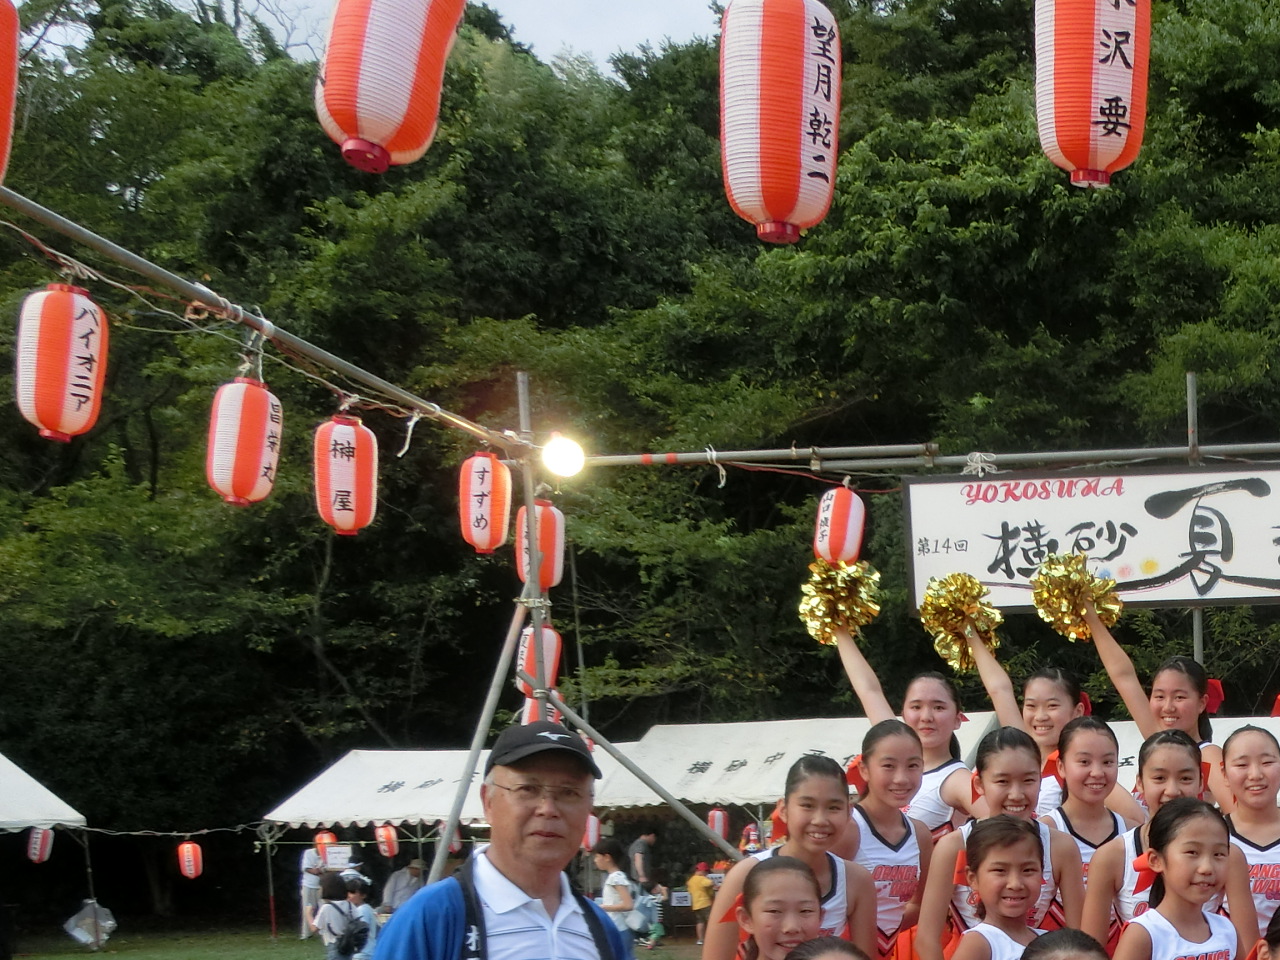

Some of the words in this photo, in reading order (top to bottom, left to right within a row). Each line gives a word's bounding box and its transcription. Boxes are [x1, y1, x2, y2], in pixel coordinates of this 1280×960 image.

[472, 466, 491, 531] すずめ
[916, 536, 968, 556] 第14回
